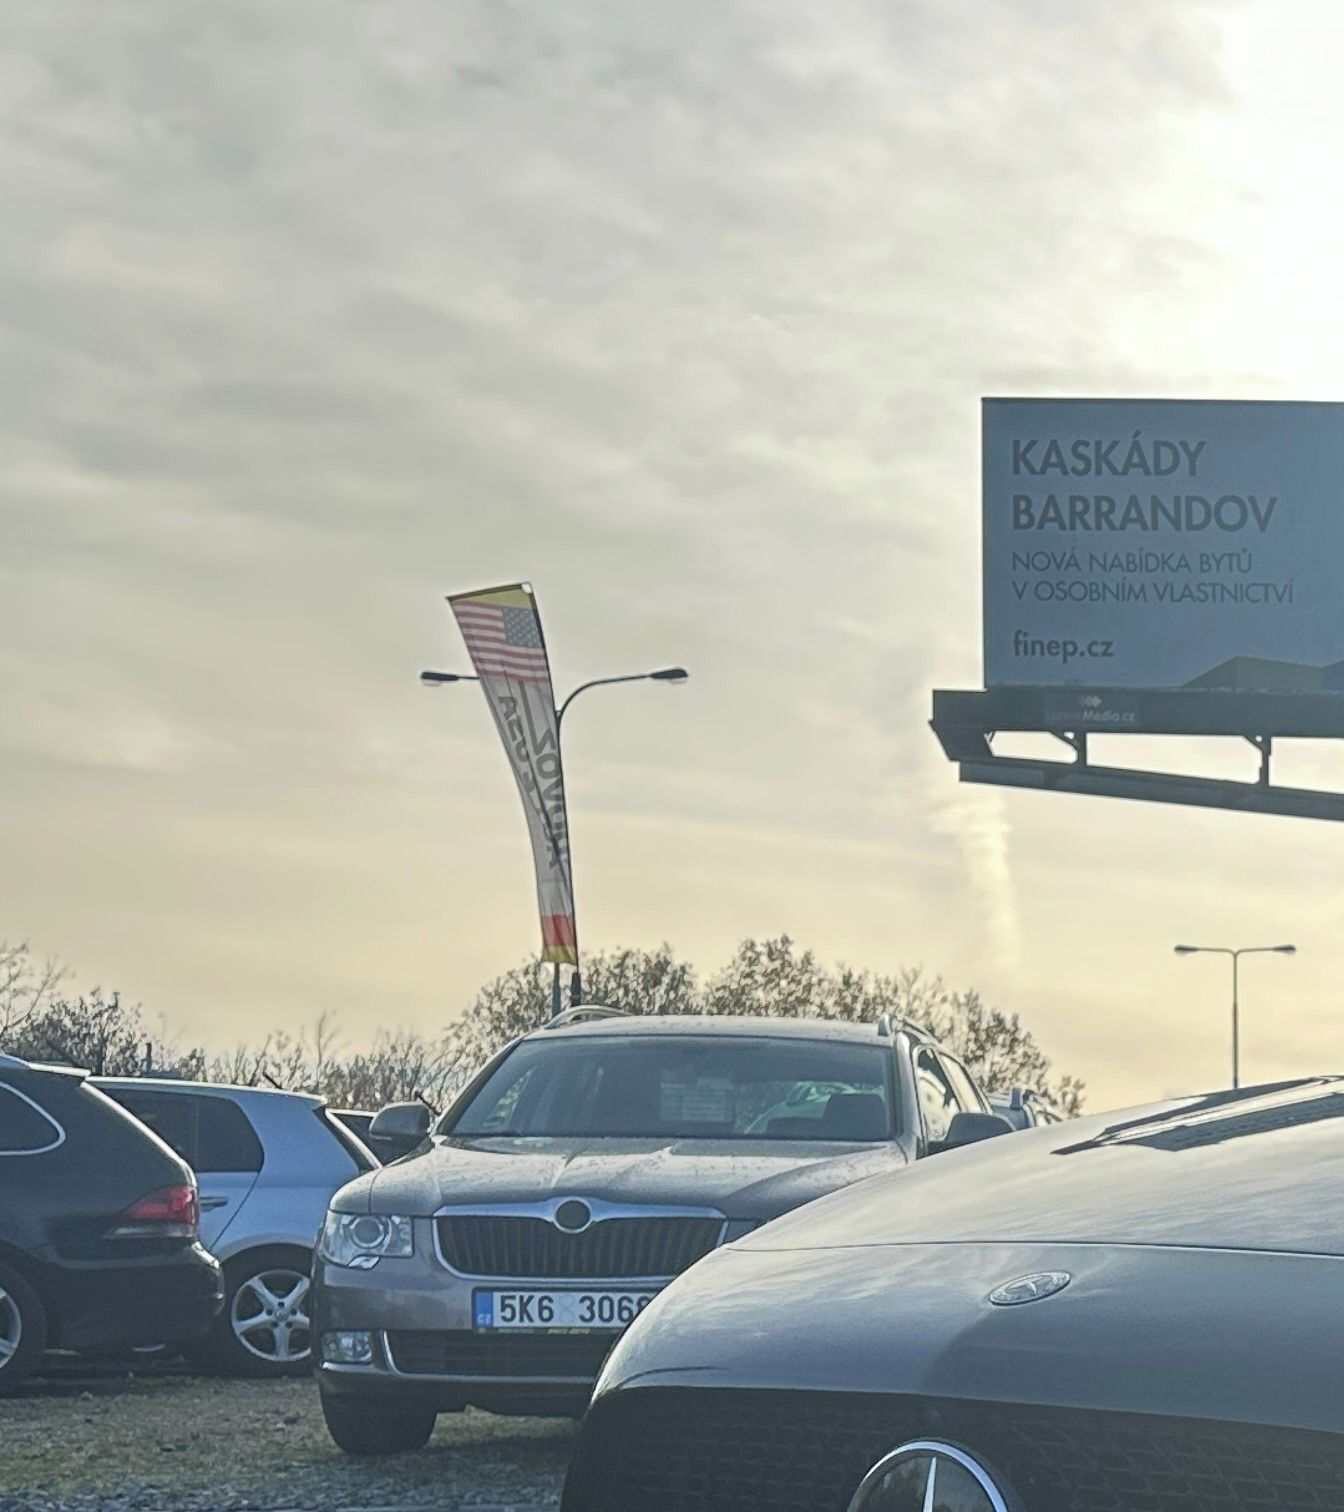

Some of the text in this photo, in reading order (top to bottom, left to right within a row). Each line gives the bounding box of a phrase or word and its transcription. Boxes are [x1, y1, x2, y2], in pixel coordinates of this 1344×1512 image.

[1012, 429, 1208, 477] KASKÁDY
[1012, 494, 1278, 532] BARRANDOV
[1012, 546, 1252, 574] NOVÁ NABÍDKA BYTŮ
[1012, 577, 1294, 603] V OSOBNÍM VLASTNICTVÍ
[1013, 629, 1115, 664] finep.cz
[500, 1295, 554, 1323] 5K6
